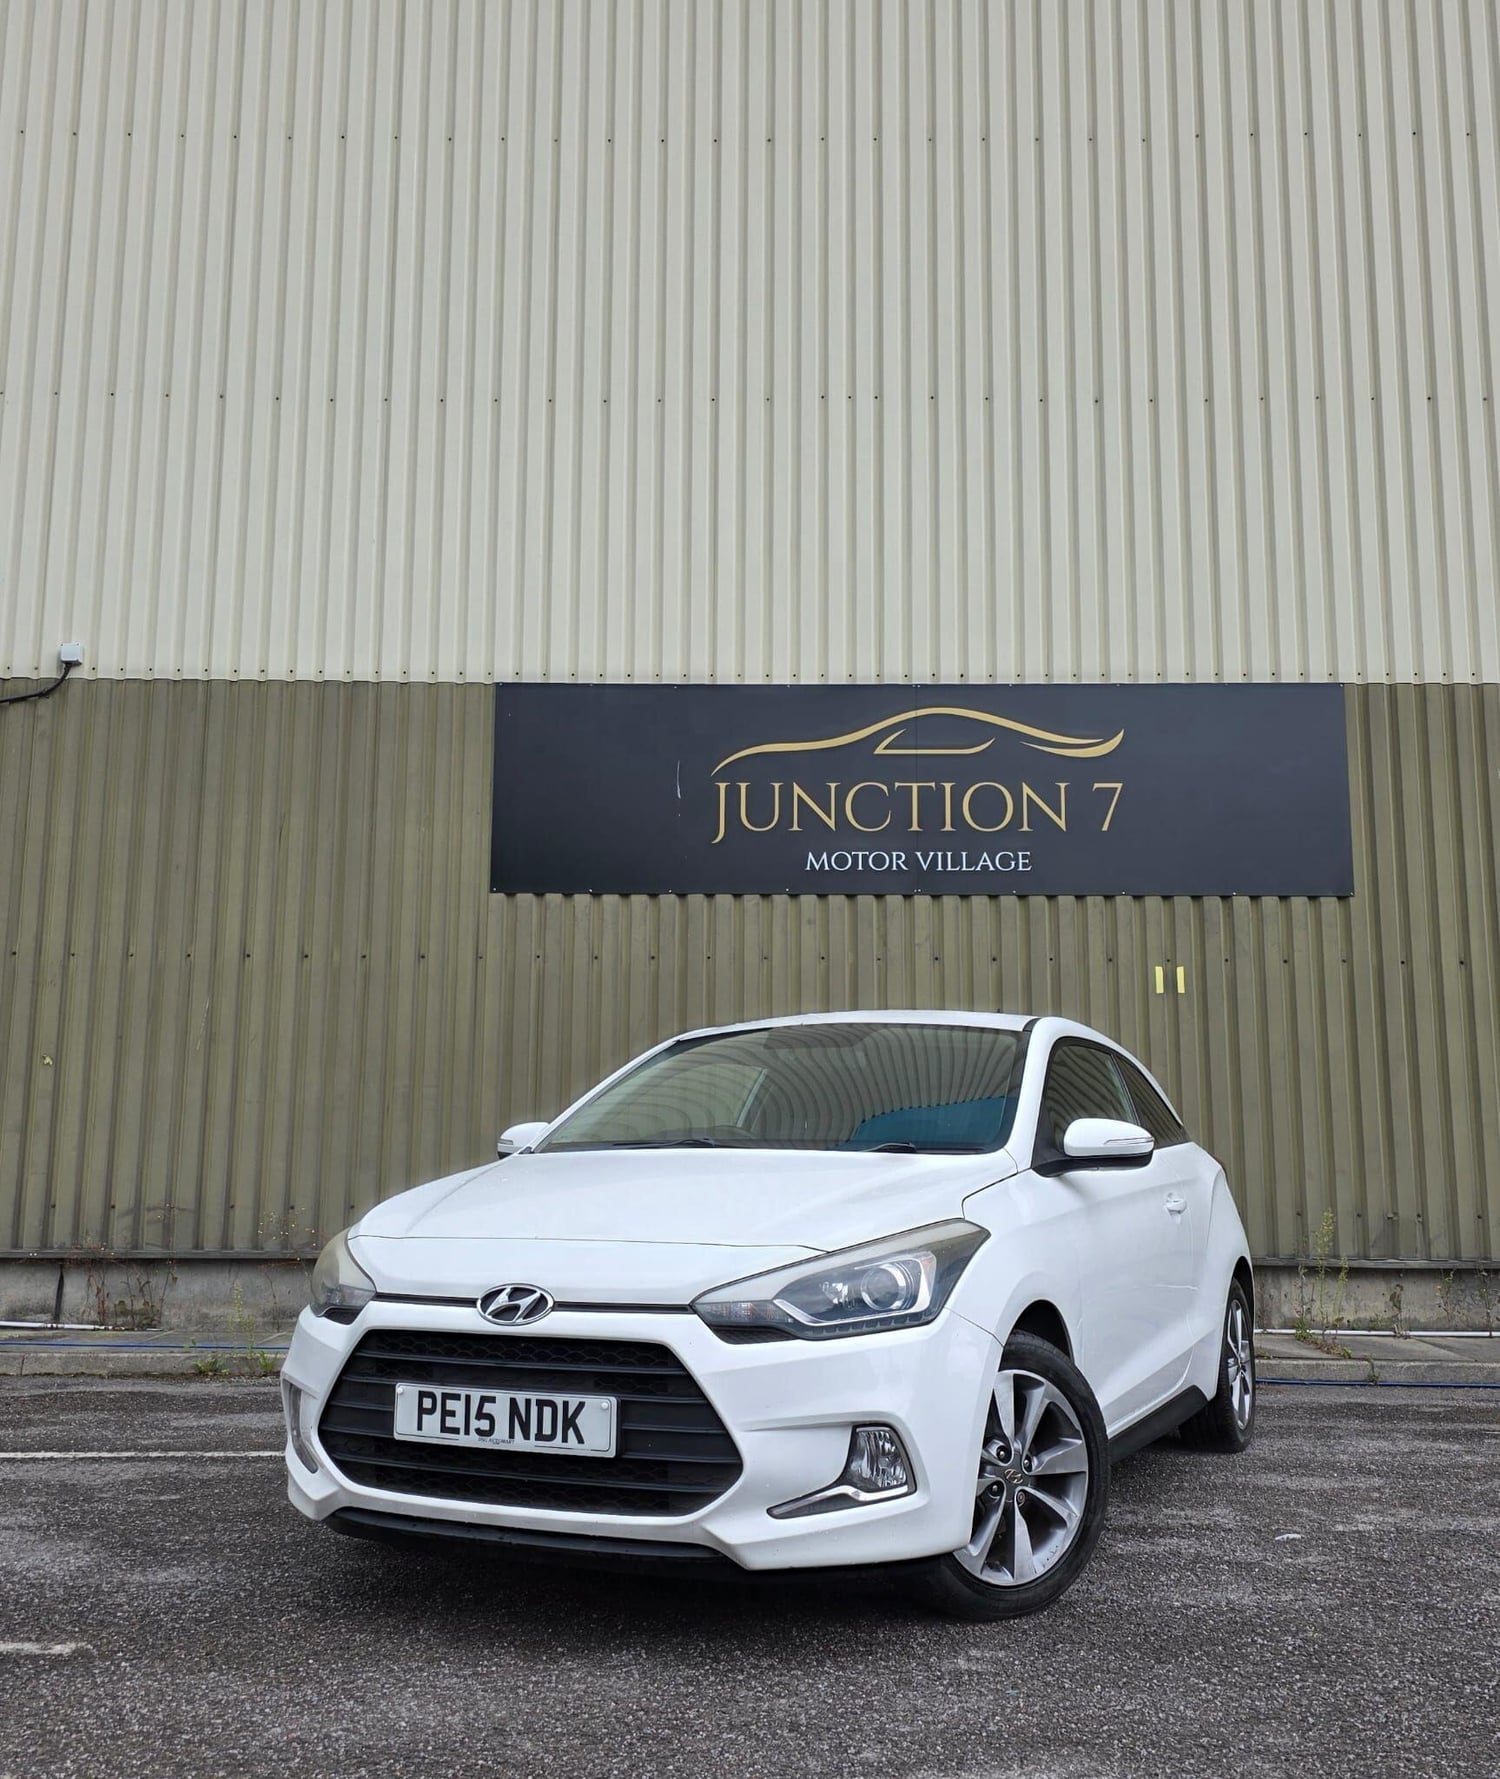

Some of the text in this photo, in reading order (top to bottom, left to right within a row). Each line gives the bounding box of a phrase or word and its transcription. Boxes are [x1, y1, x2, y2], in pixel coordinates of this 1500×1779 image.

[711, 782, 1124, 844] JUNCTION 7
[805, 851, 1032, 872] MOTOR VILLAGE
[417, 1390, 586, 1444] PE15 NDK
